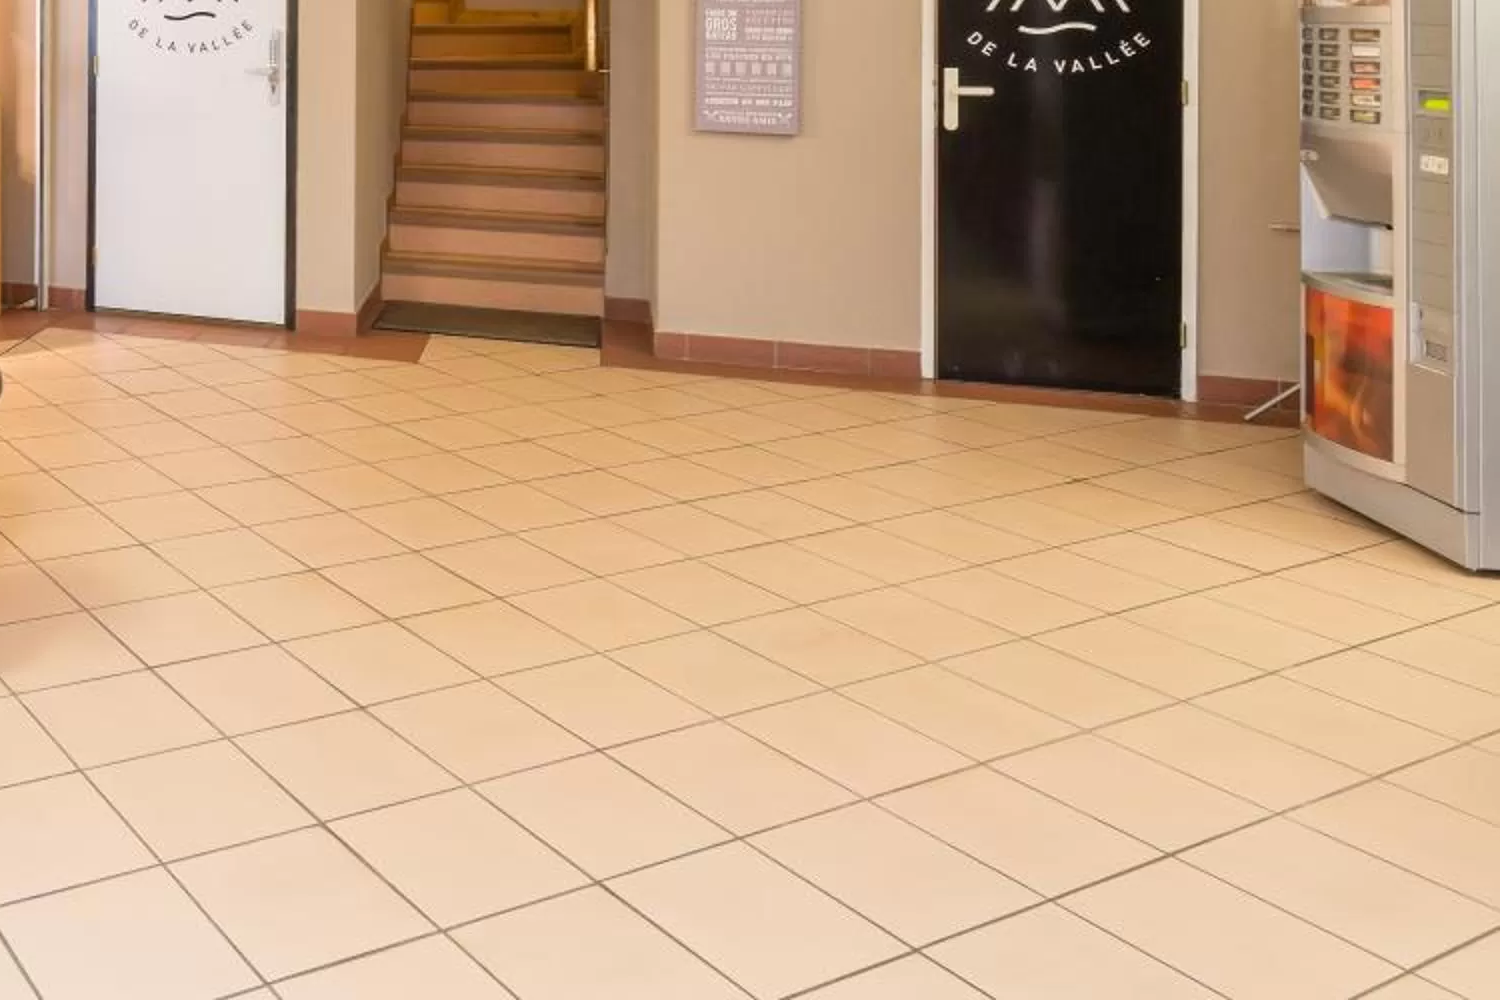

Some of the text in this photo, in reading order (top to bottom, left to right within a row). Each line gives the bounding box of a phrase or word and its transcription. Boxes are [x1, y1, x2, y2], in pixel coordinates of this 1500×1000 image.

[129, 19, 252, 53] DE LA VALLÉE
[966, 31, 1152, 74] DE LA VALLÉE
